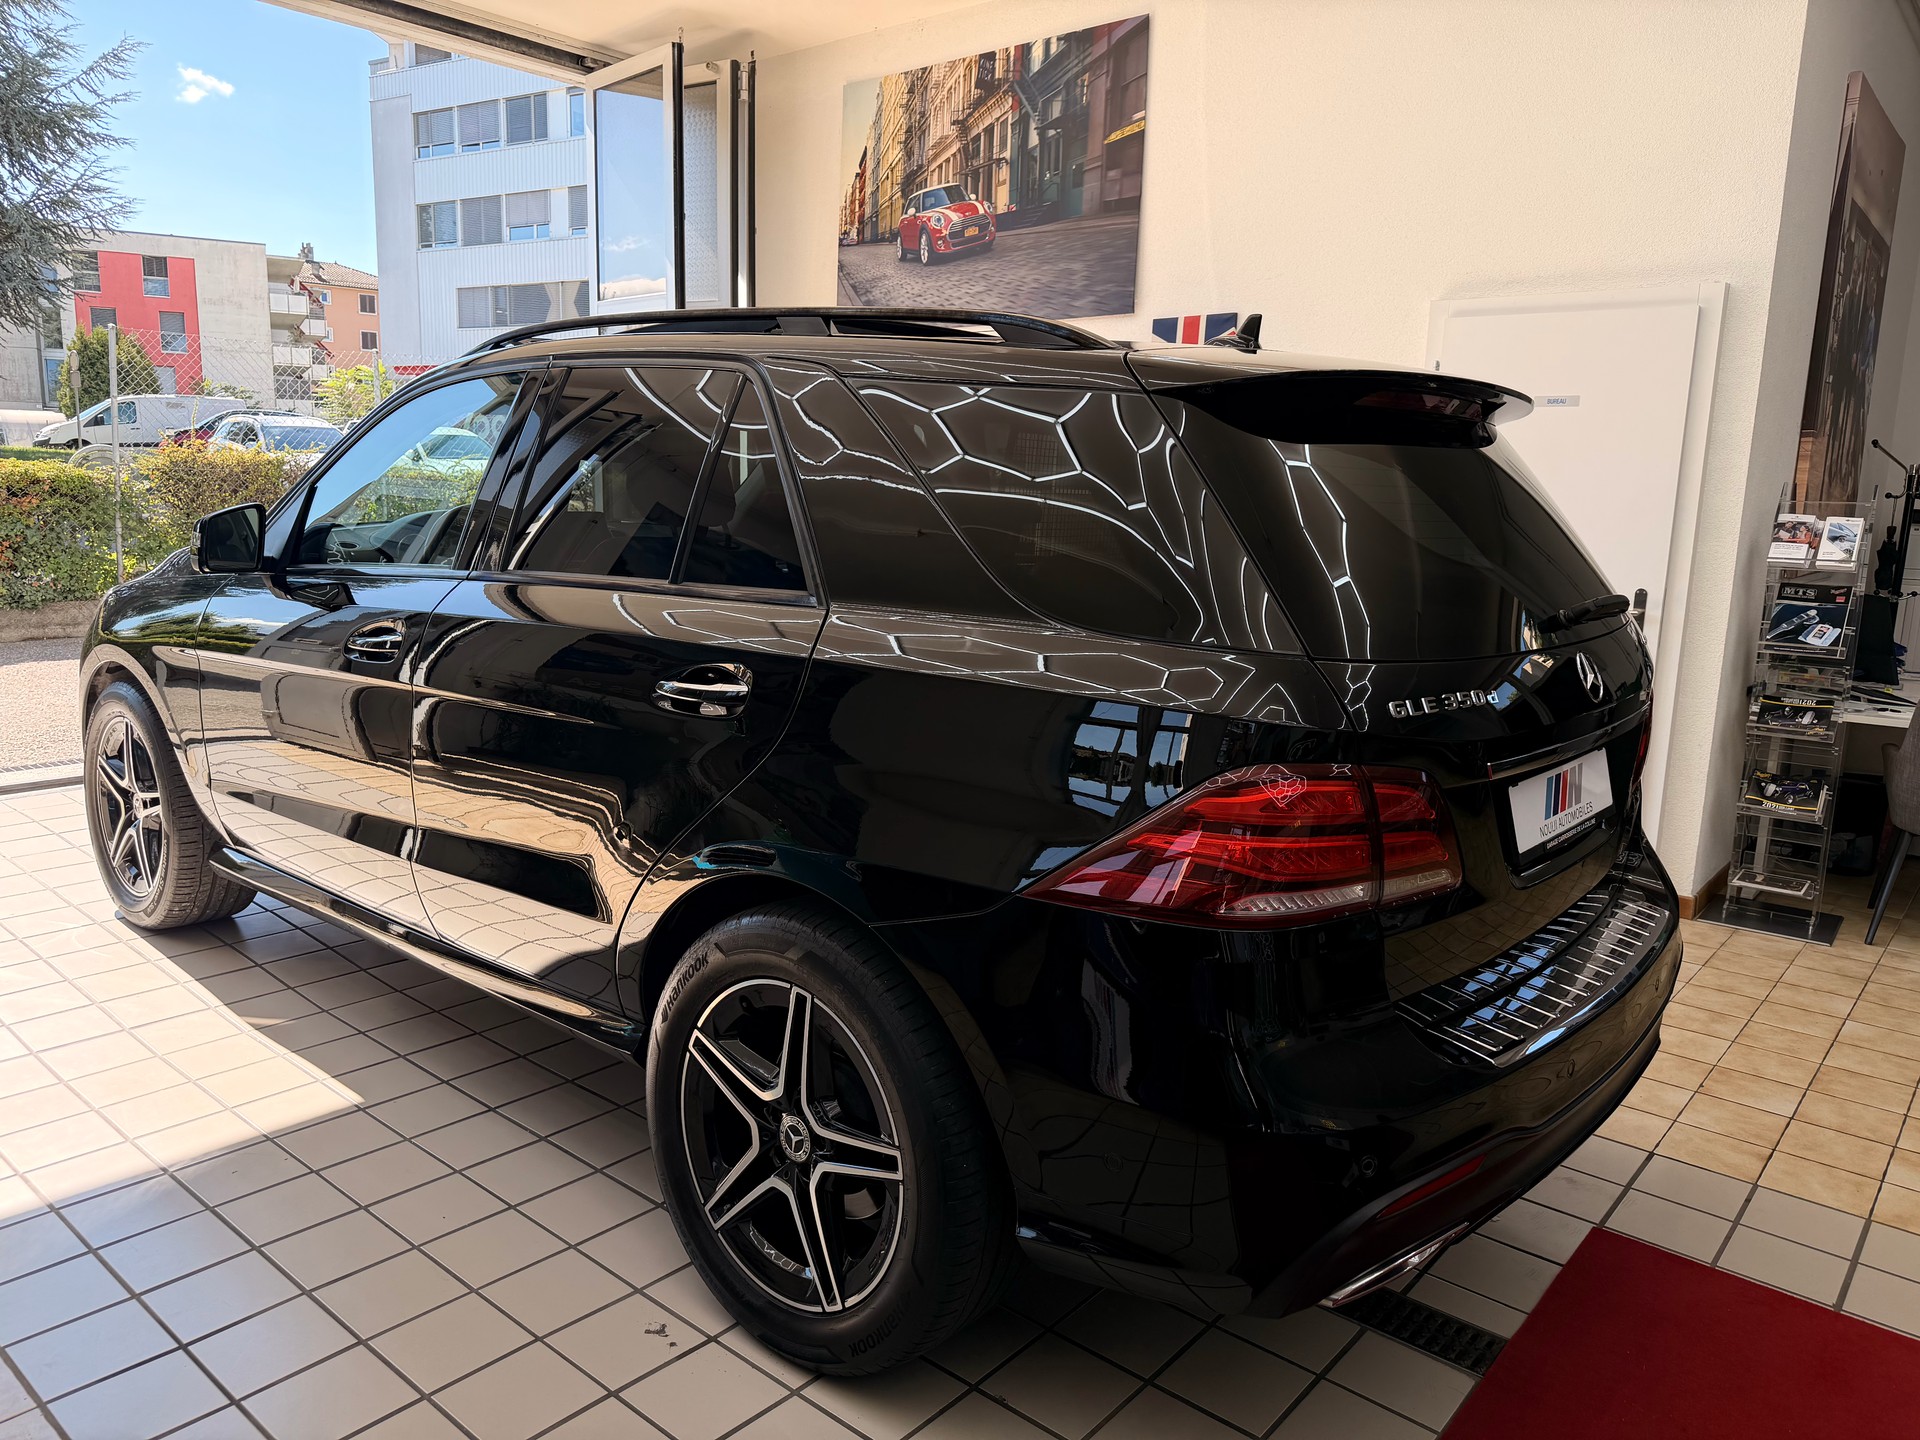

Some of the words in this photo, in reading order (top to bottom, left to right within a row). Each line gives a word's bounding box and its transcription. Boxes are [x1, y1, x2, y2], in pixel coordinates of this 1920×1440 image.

[1783, 587, 1816, 597] MTS
[1388, 696, 1440, 718] GLE
[1558, 801, 1594, 828] AUTOMOBILES
